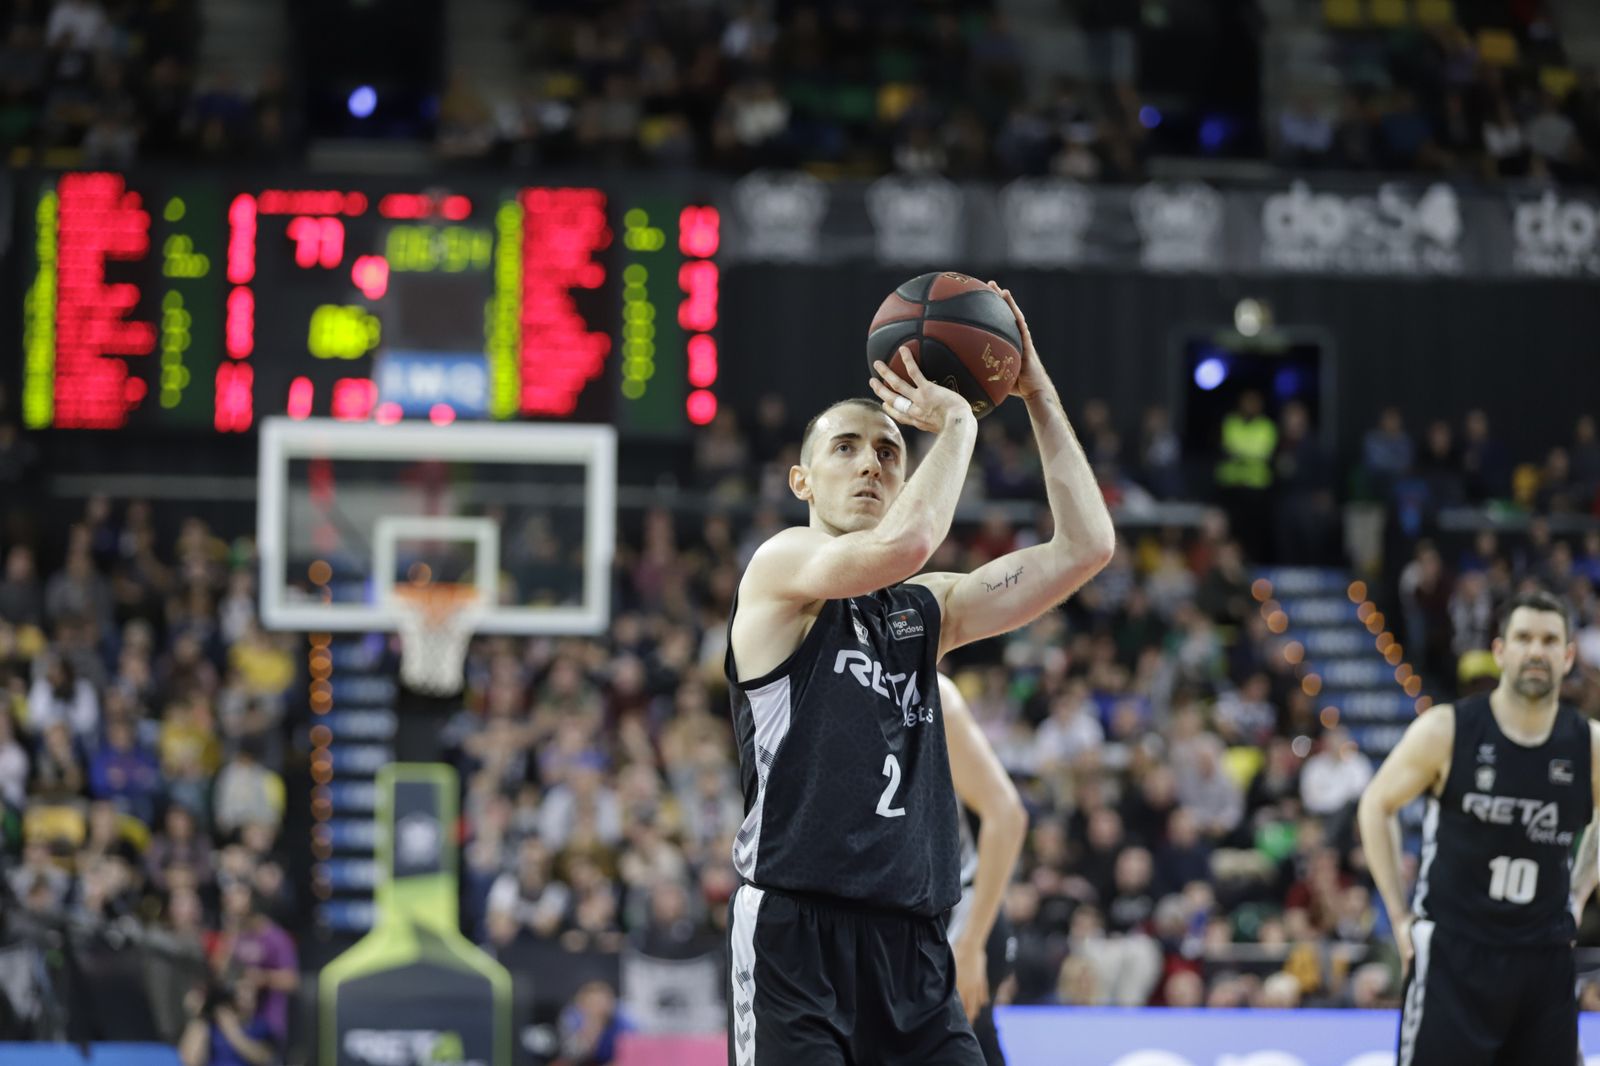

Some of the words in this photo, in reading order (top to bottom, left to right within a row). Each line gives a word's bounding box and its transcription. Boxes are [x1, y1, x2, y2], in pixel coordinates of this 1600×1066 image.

[892, 620, 908, 629] liga
[896, 625, 924, 635] endesa
[875, 753, 906, 818] 2
[1462, 792, 1559, 836] RETA
[1488, 855, 1539, 905] 10
